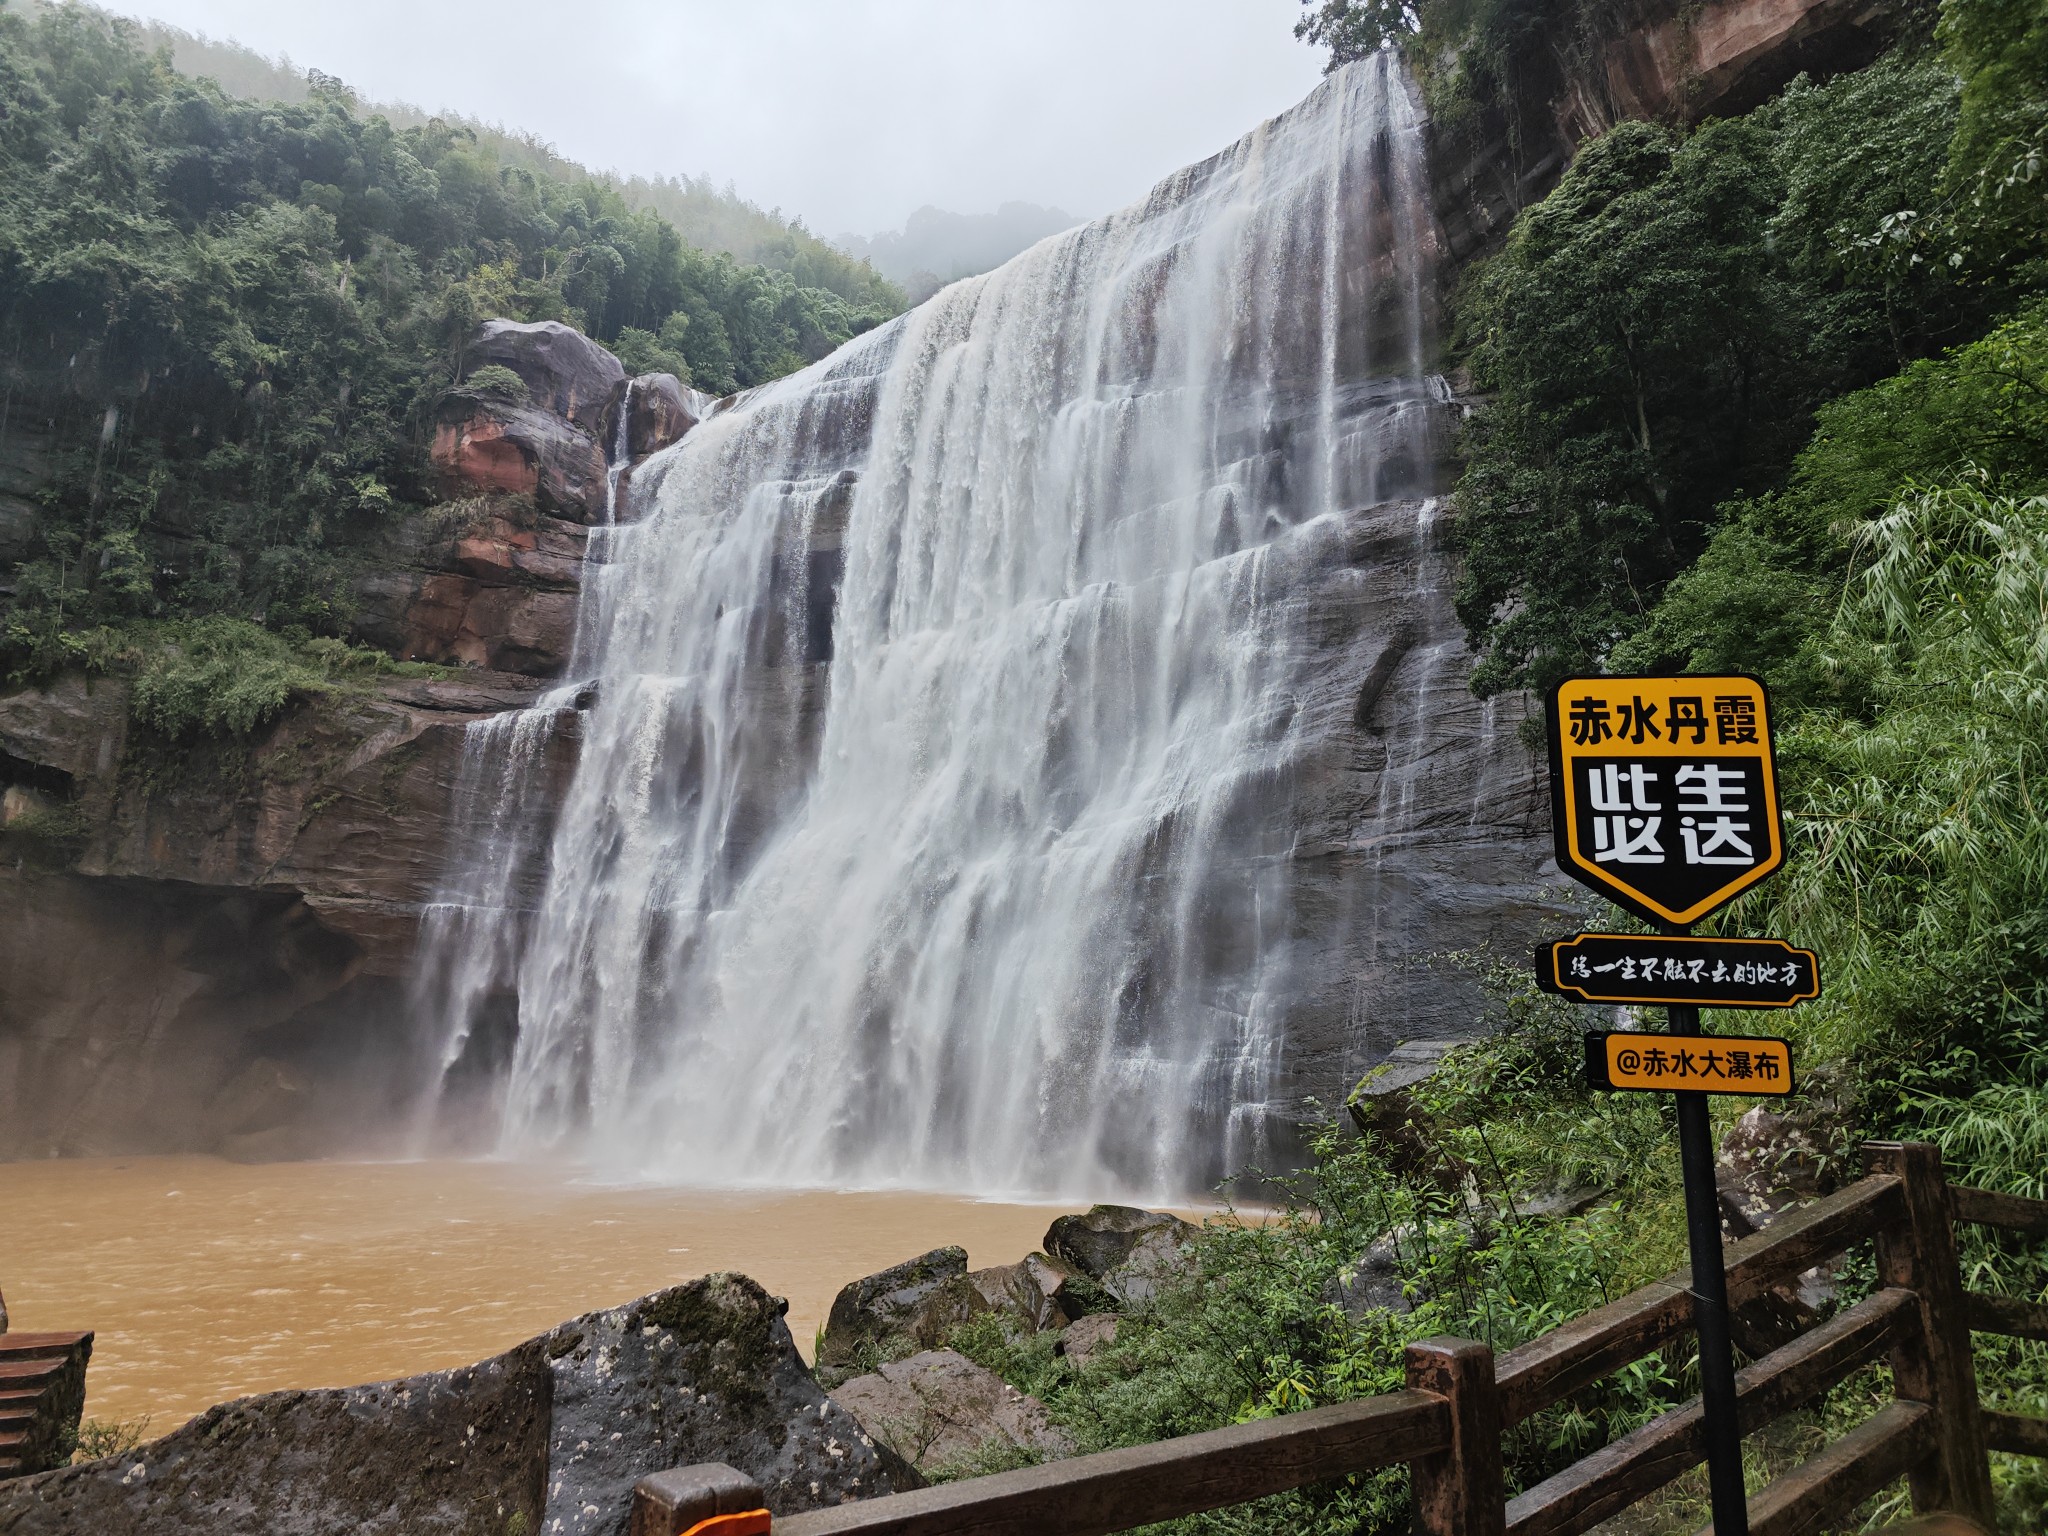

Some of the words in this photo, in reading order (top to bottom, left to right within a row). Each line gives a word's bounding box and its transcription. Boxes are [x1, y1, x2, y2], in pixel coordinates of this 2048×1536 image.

[1569, 696, 1760, 746] 赤水丹霞
[1588, 764, 1750, 812] 此生
[1594, 816, 1755, 866] 必达
[1616, 1048, 1780, 1081] @赤水大瀑布
